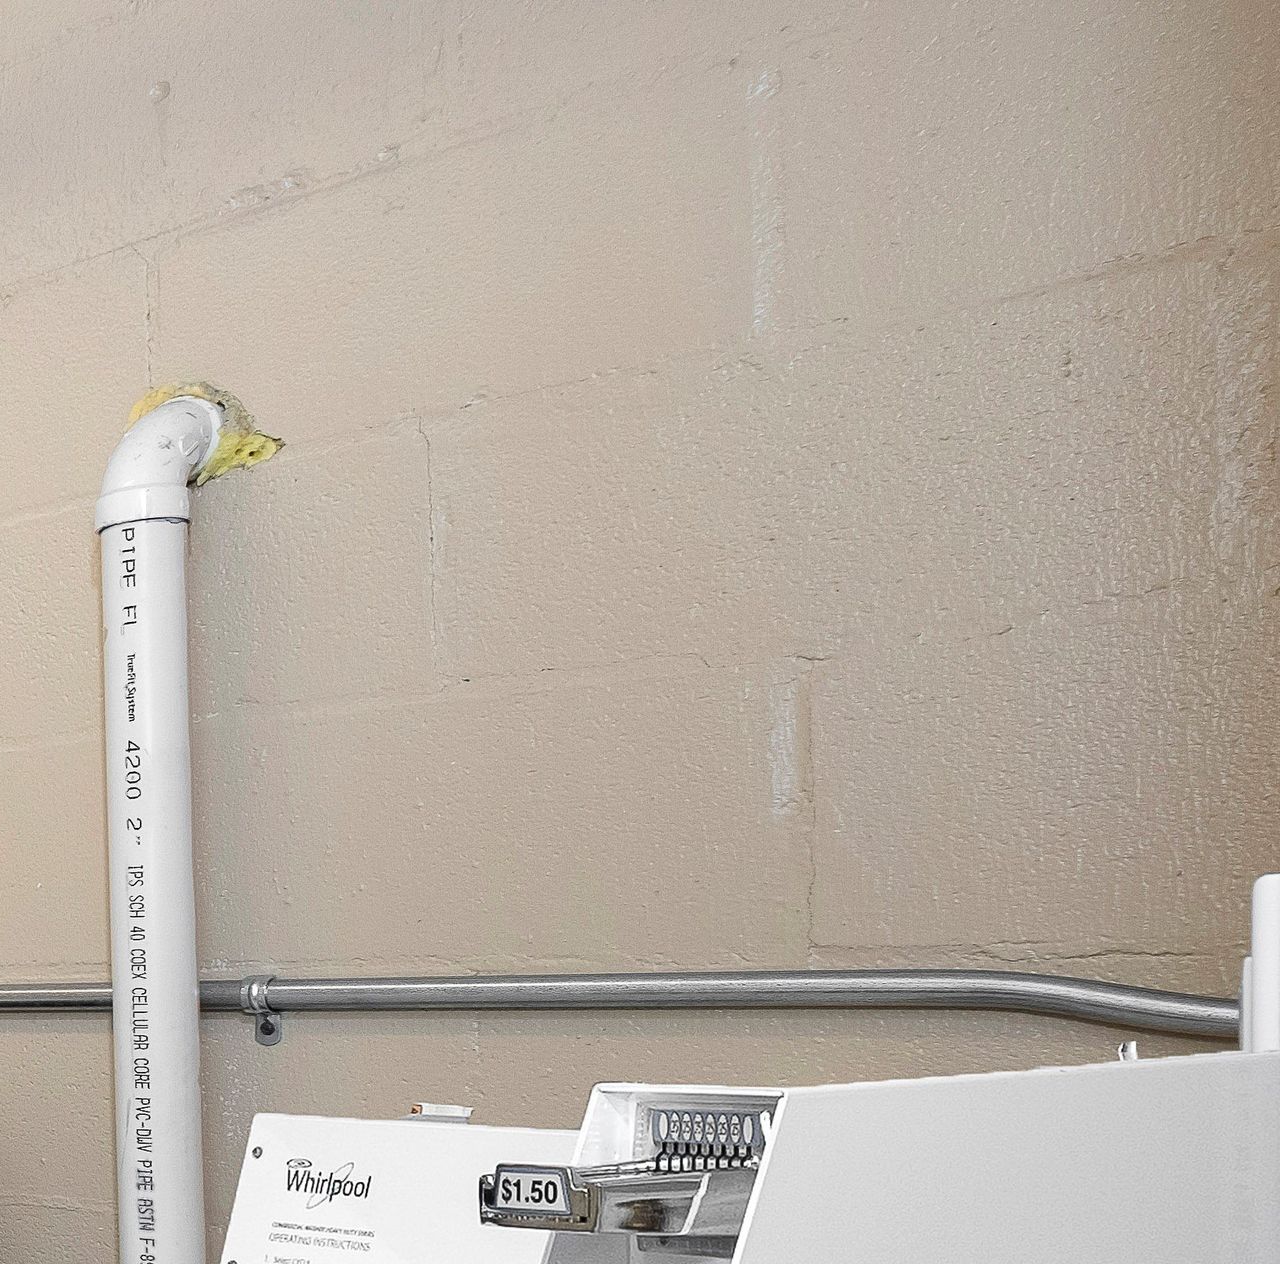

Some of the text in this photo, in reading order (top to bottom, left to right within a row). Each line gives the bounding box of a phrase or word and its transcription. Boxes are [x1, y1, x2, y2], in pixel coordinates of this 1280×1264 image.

[125, 740, 142, 800] 4200
[128, 864, 144, 888] IPS
[128, 894, 146, 919] SCH
[129, 925, 146, 942] 40
[130, 948, 147, 981] COEX
[131, 987, 149, 1051] CELLULAR
[134, 1057, 151, 1090] CORE
[135, 1097, 153, 1154] PVC-DWV
[136, 1159, 154, 1192] PIPE
[286, 1169, 372, 1202] Whirlpool
[501, 1176, 558, 1205] $1.50
[138, 1198, 155, 1232] ASTM
